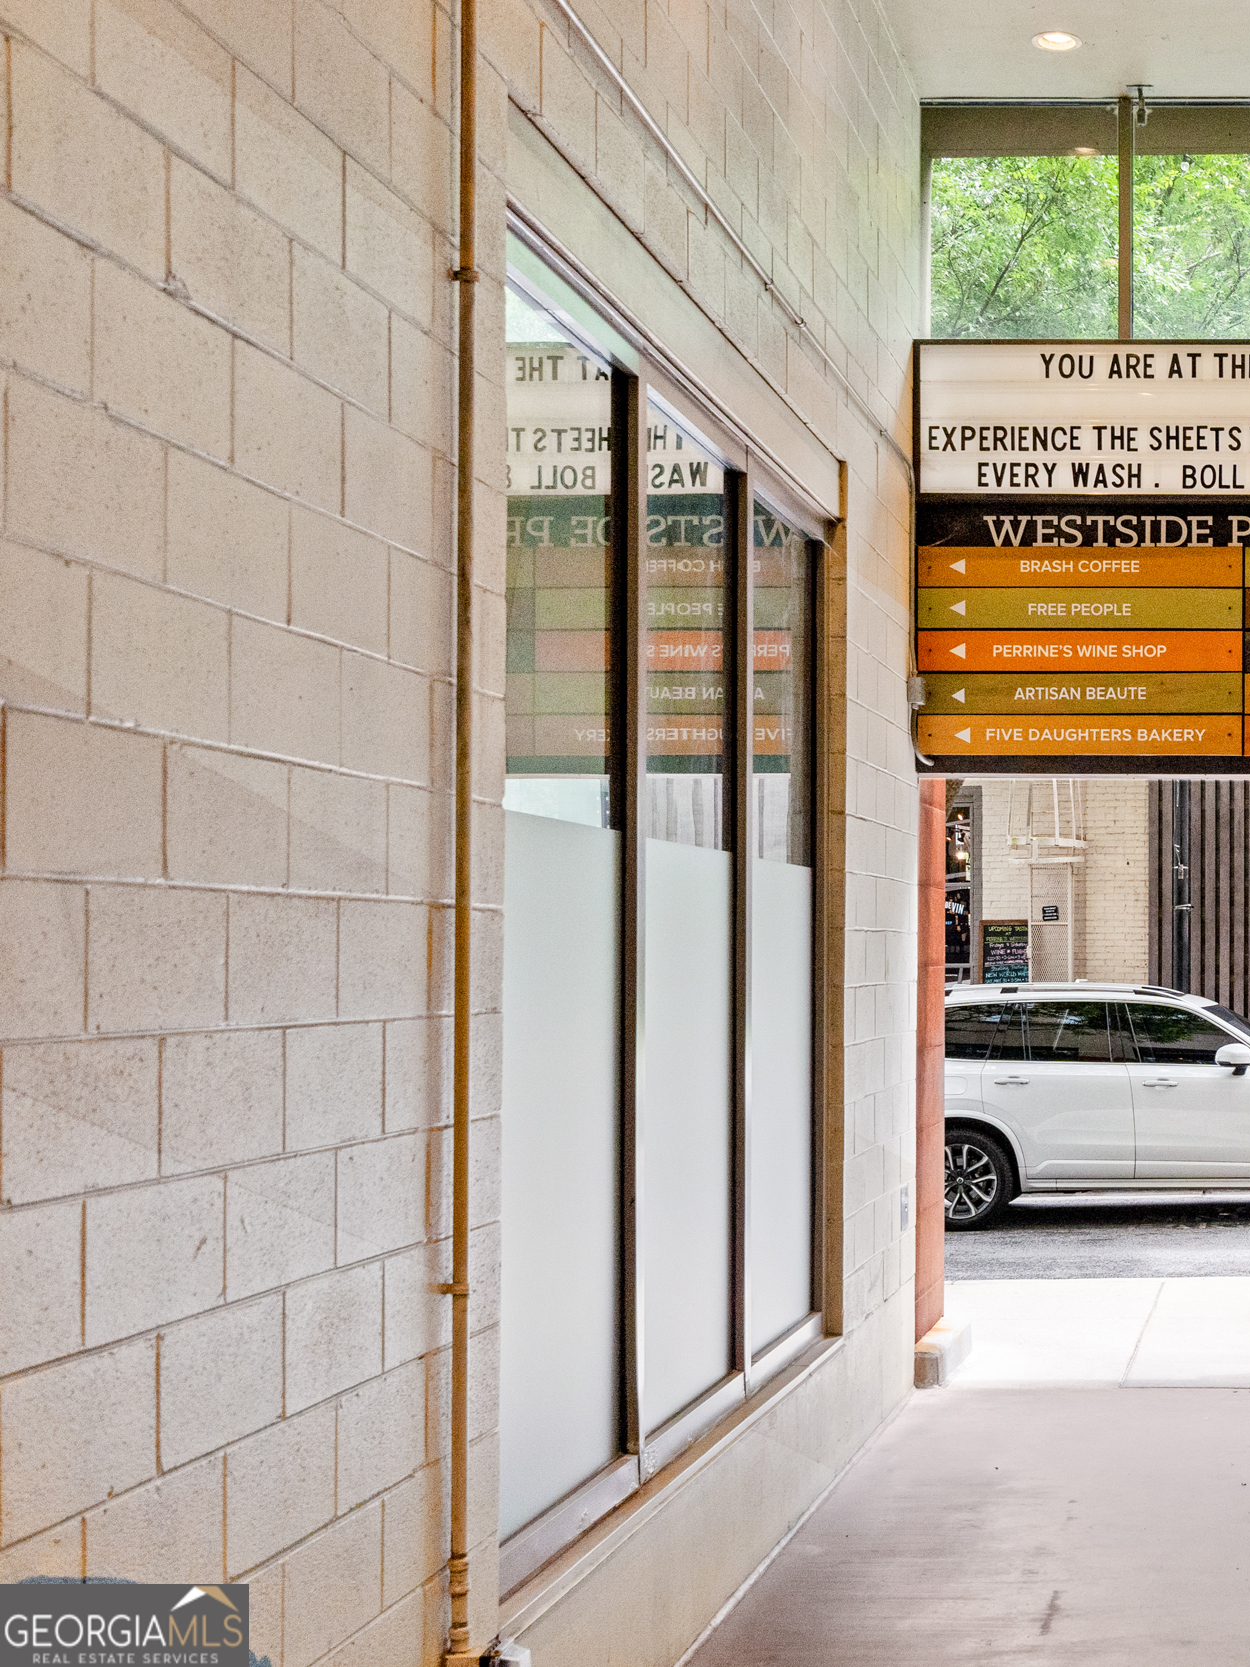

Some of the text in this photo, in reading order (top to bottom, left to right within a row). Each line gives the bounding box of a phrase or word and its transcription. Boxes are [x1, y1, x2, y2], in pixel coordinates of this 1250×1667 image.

[1040, 353, 1094, 379] YOU
[1108, 353, 1155, 379] ARE
[1168, 353, 1201, 379] AT
[928, 425, 1081, 452] EXPERIENCE
[1092, 425, 1138, 452] THE
[1149, 425, 1242, 452] SHEETS
[977, 462, 1057, 488] EVERY
[1182, 464, 1244, 489] BOLL
[983, 515, 1213, 548] WESTSIDE
[1019, 560, 1140, 573] BRASH COFFEE
[1027, 603, 1132, 616] FREE PEOPLE
[992, 644, 1167, 658] PERRINE'S WINE SHOP
[1014, 687, 1147, 700] ARTISAN BEAUTE
[985, 728, 1206, 742] FIVE DAUGHTERS BAKERY
